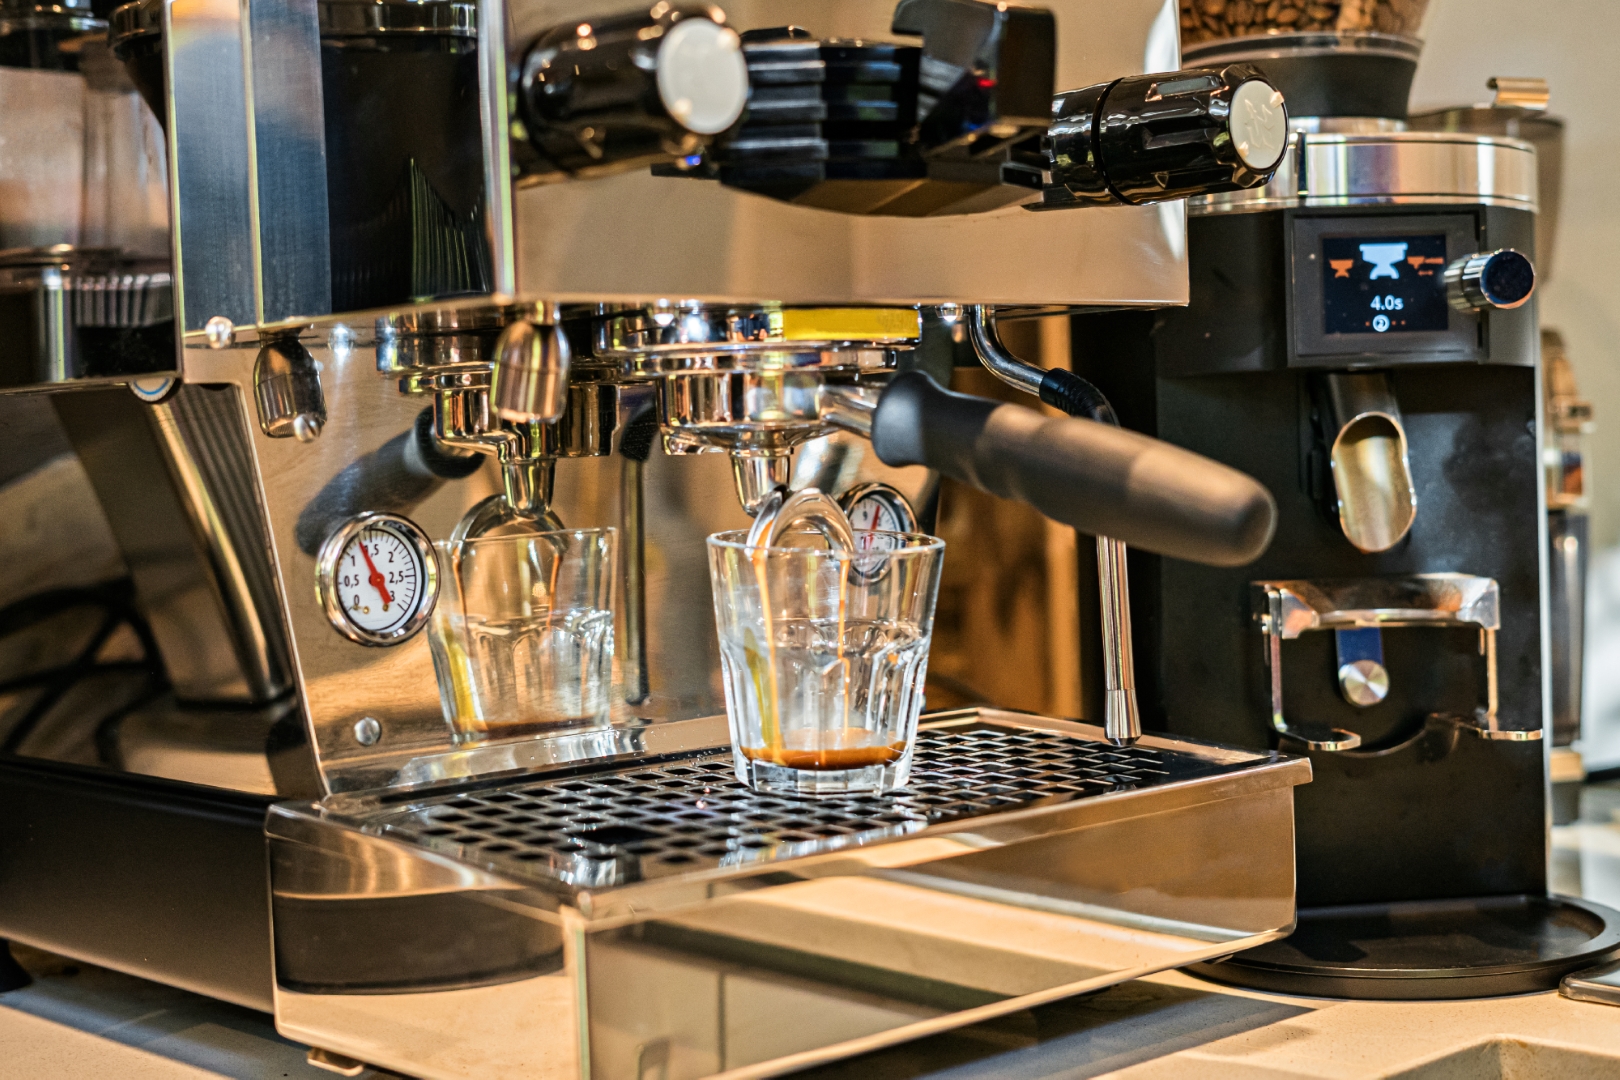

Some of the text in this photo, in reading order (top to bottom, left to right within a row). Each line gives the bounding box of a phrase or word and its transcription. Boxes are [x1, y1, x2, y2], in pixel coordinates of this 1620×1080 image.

[1370, 295, 1404, 310] 4.0s
[351, 555, 356, 566] 1
[388, 552, 394, 563] 2
[344, 574, 359, 588] 0,5
[389, 571, 404, 584] 2,5
[354, 594, 359, 605] 0
[390, 591, 395, 601] 3
